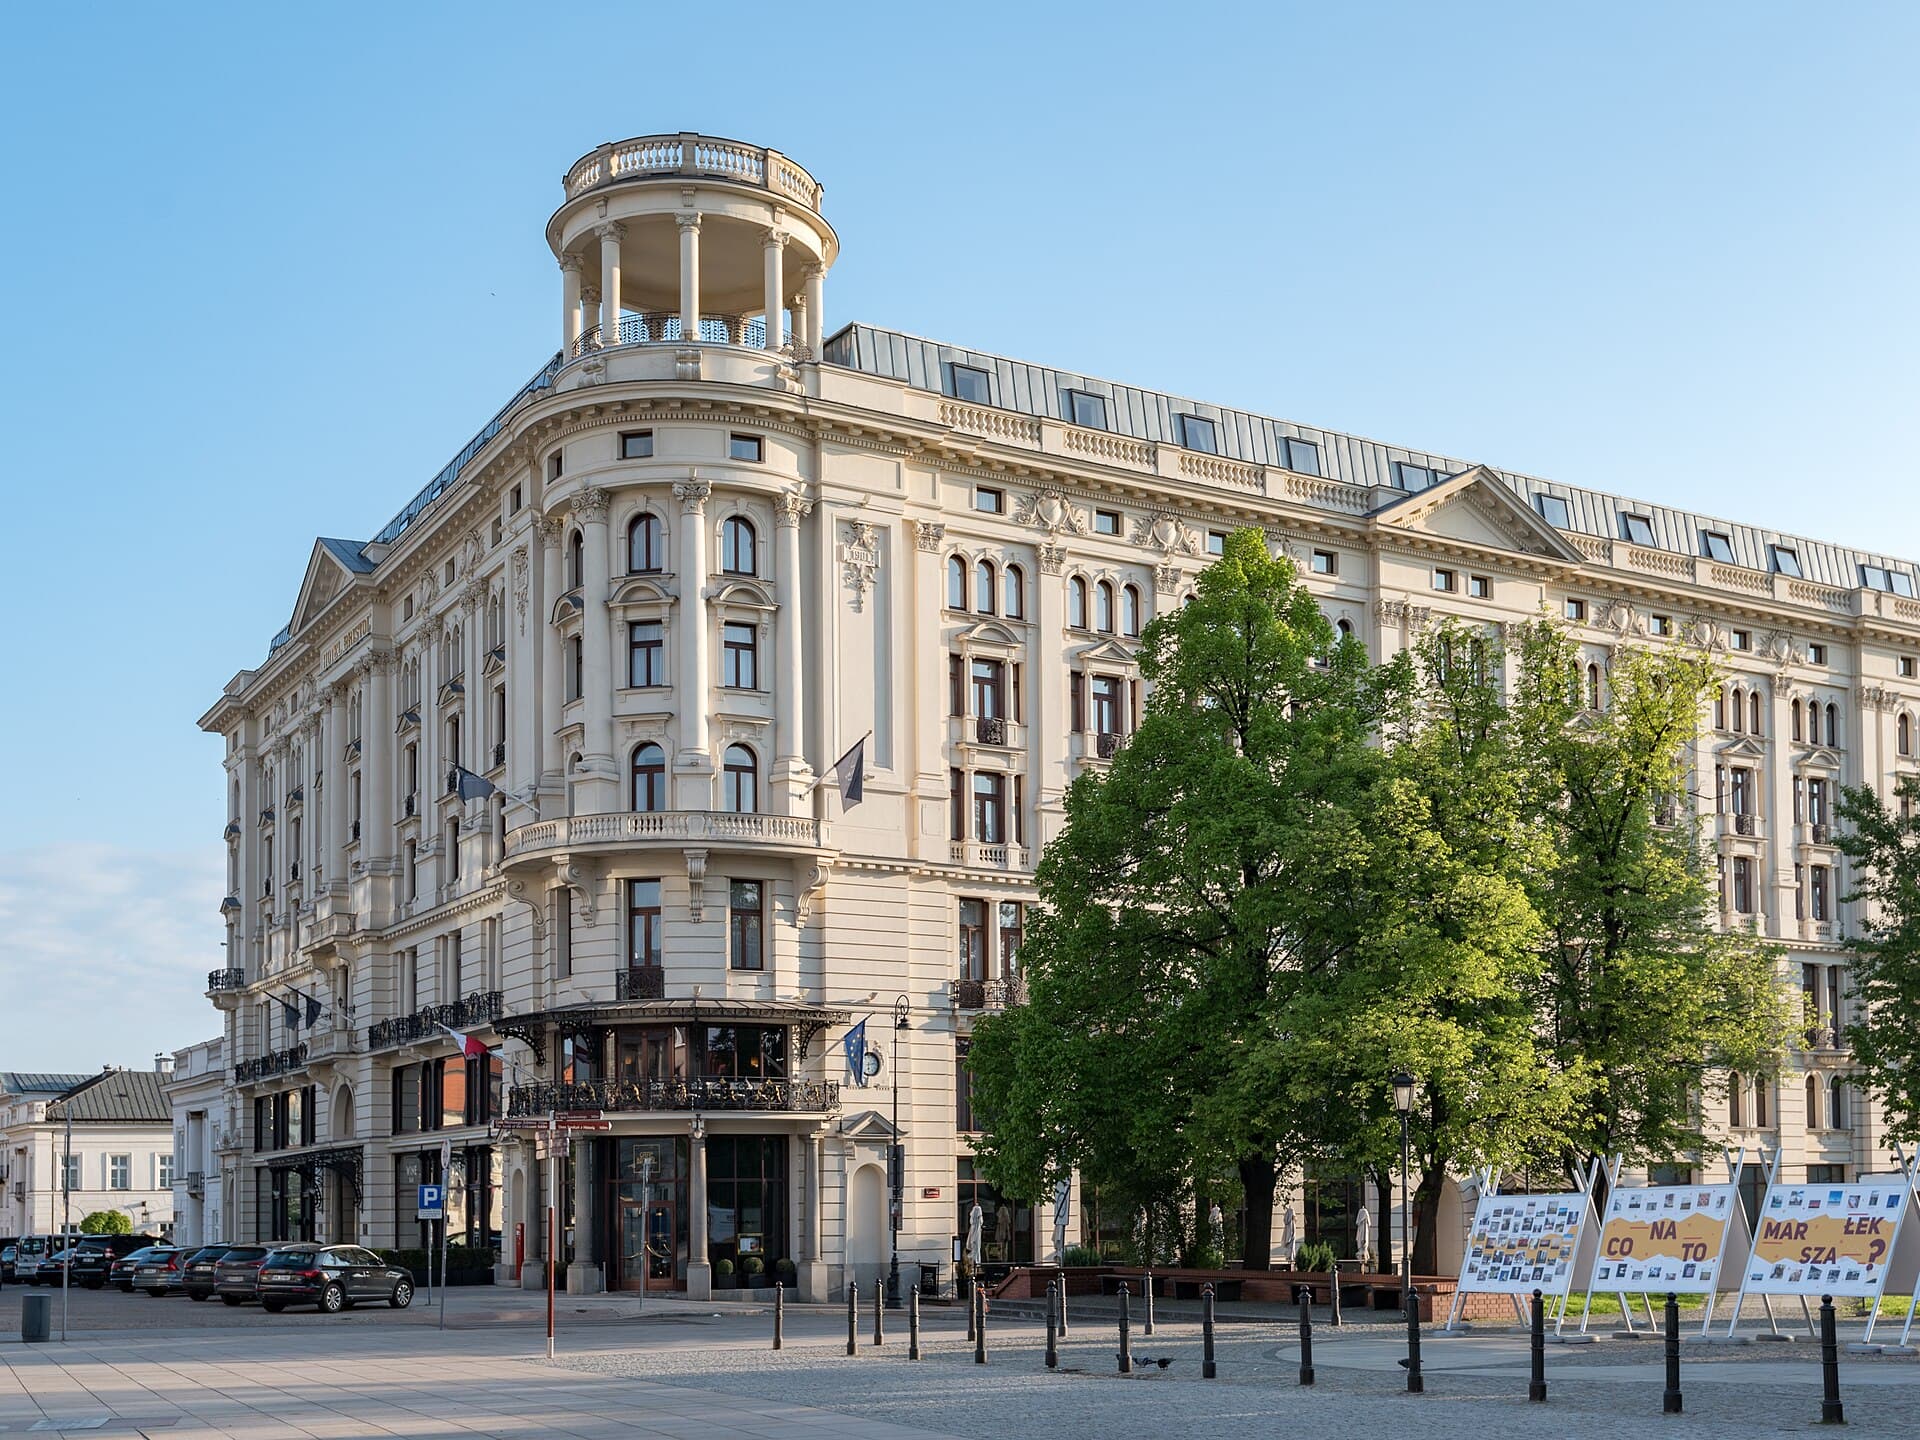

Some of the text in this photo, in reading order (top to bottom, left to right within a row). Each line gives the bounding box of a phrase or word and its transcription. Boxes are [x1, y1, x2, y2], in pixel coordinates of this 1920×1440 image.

[424, 1188, 438, 1206] P
[1606, 1221, 1707, 1262] CO NA TO
[1763, 1216, 1886, 1271] MAR SZA ŁEK ?
